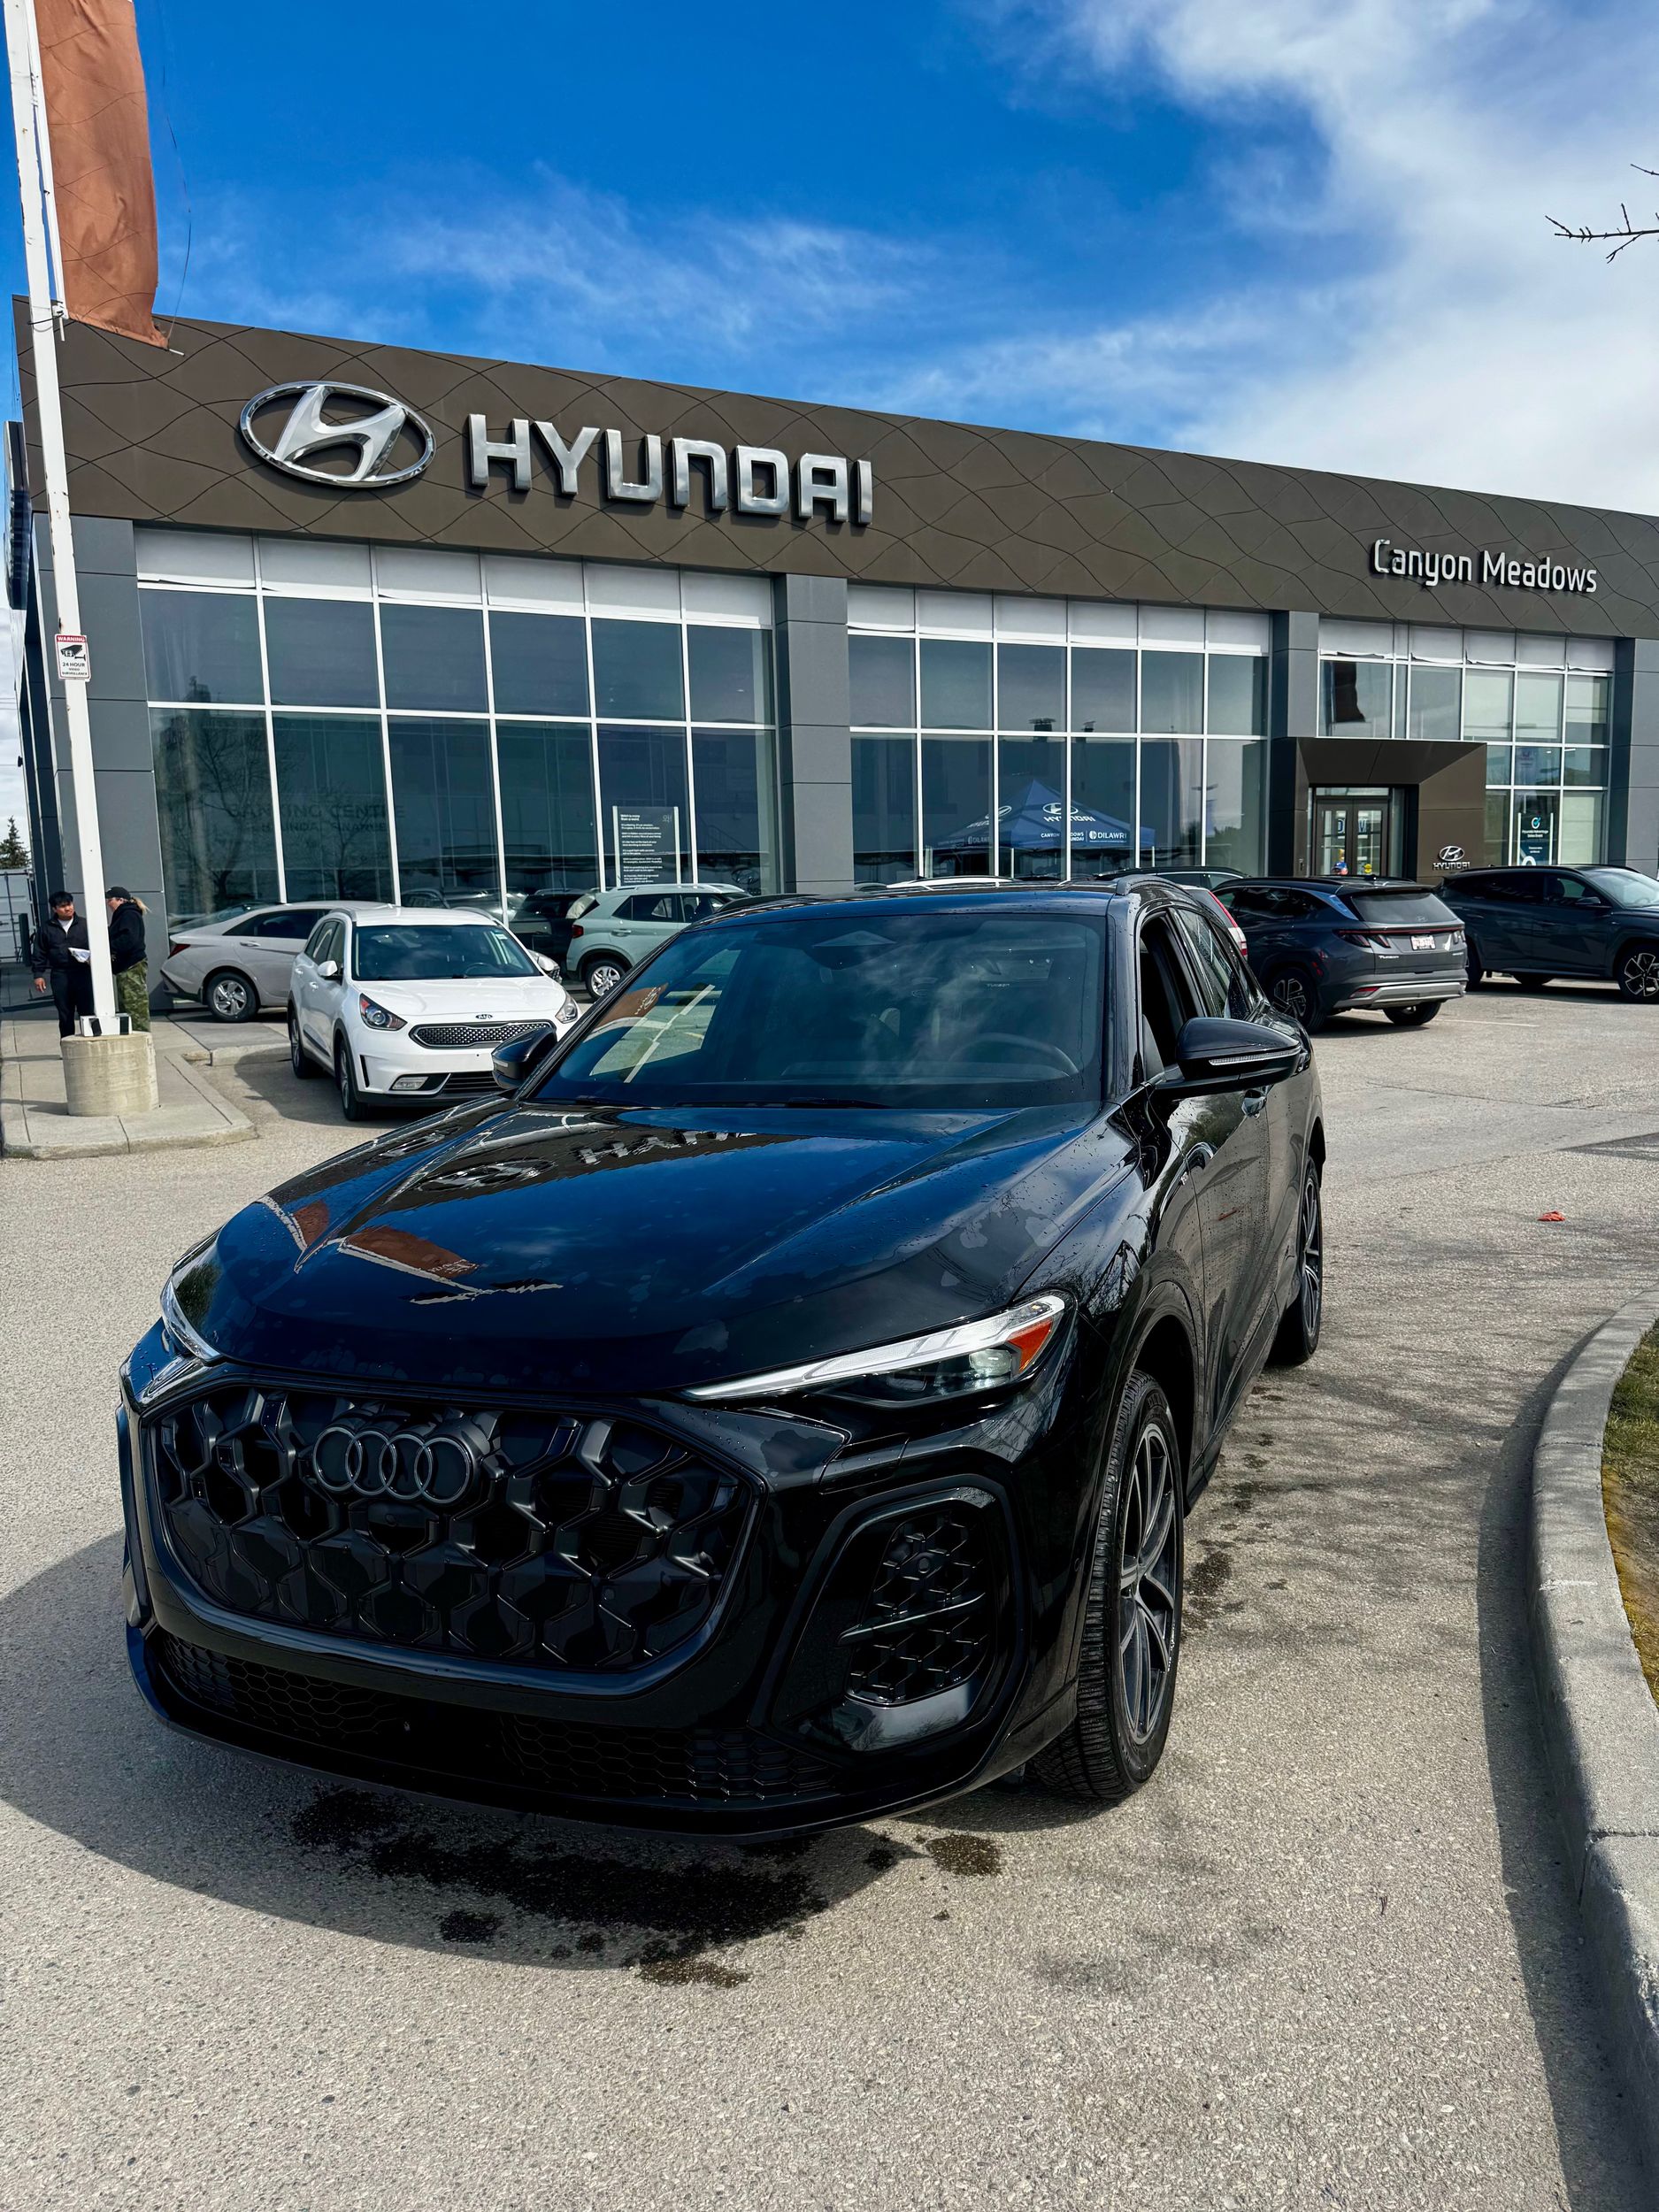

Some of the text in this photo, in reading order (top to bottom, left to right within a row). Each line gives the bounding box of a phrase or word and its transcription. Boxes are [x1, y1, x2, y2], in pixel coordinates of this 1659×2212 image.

[468, 413, 873, 525] HYUNDAI
[1374, 539, 1597, 594] Canyon Meadows
[1432, 861, 1471, 870] HYUNDAI
